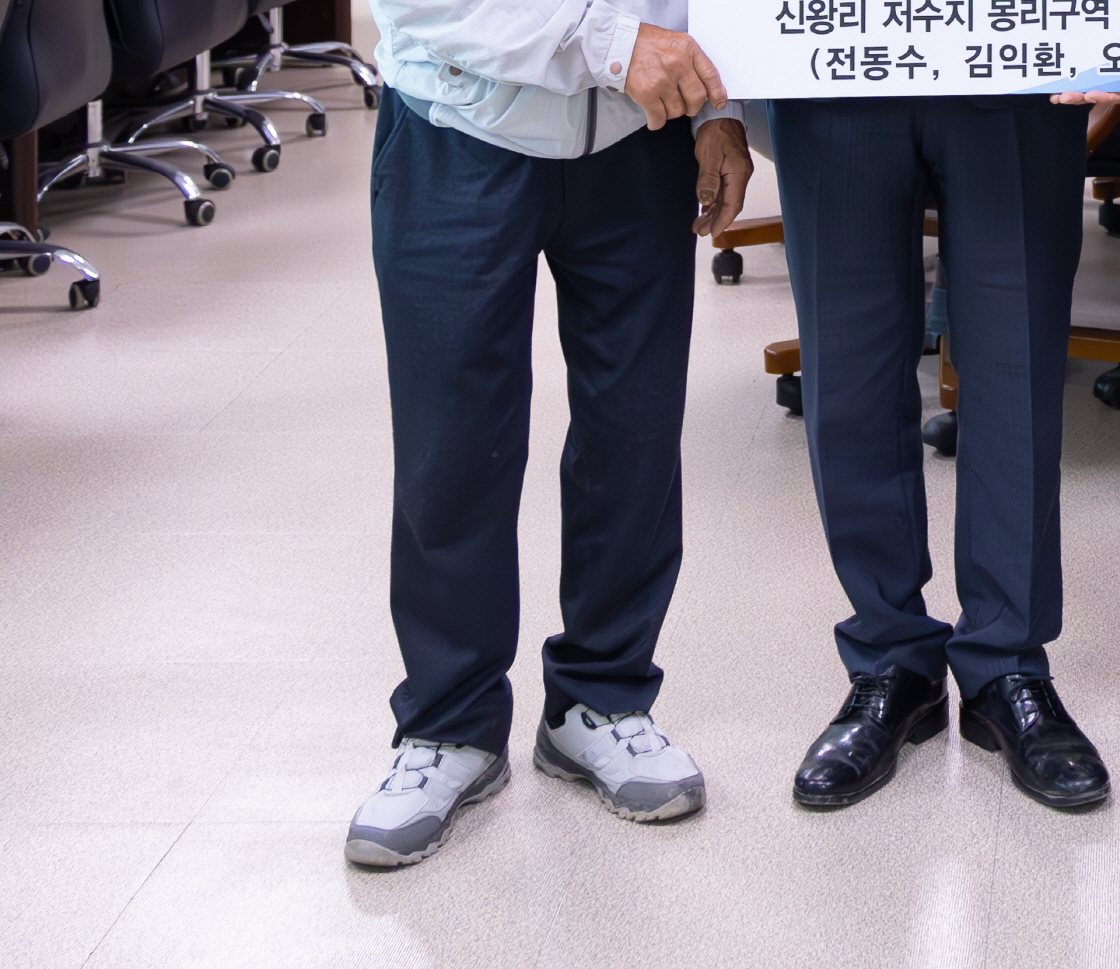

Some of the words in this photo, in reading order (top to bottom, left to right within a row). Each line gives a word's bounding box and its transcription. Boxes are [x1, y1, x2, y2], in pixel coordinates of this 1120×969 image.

[775, 0, 867, 35] 신왕리
[810, 45, 940, 82] (전동수,
[964, 42, 1077, 79] 김익환,
